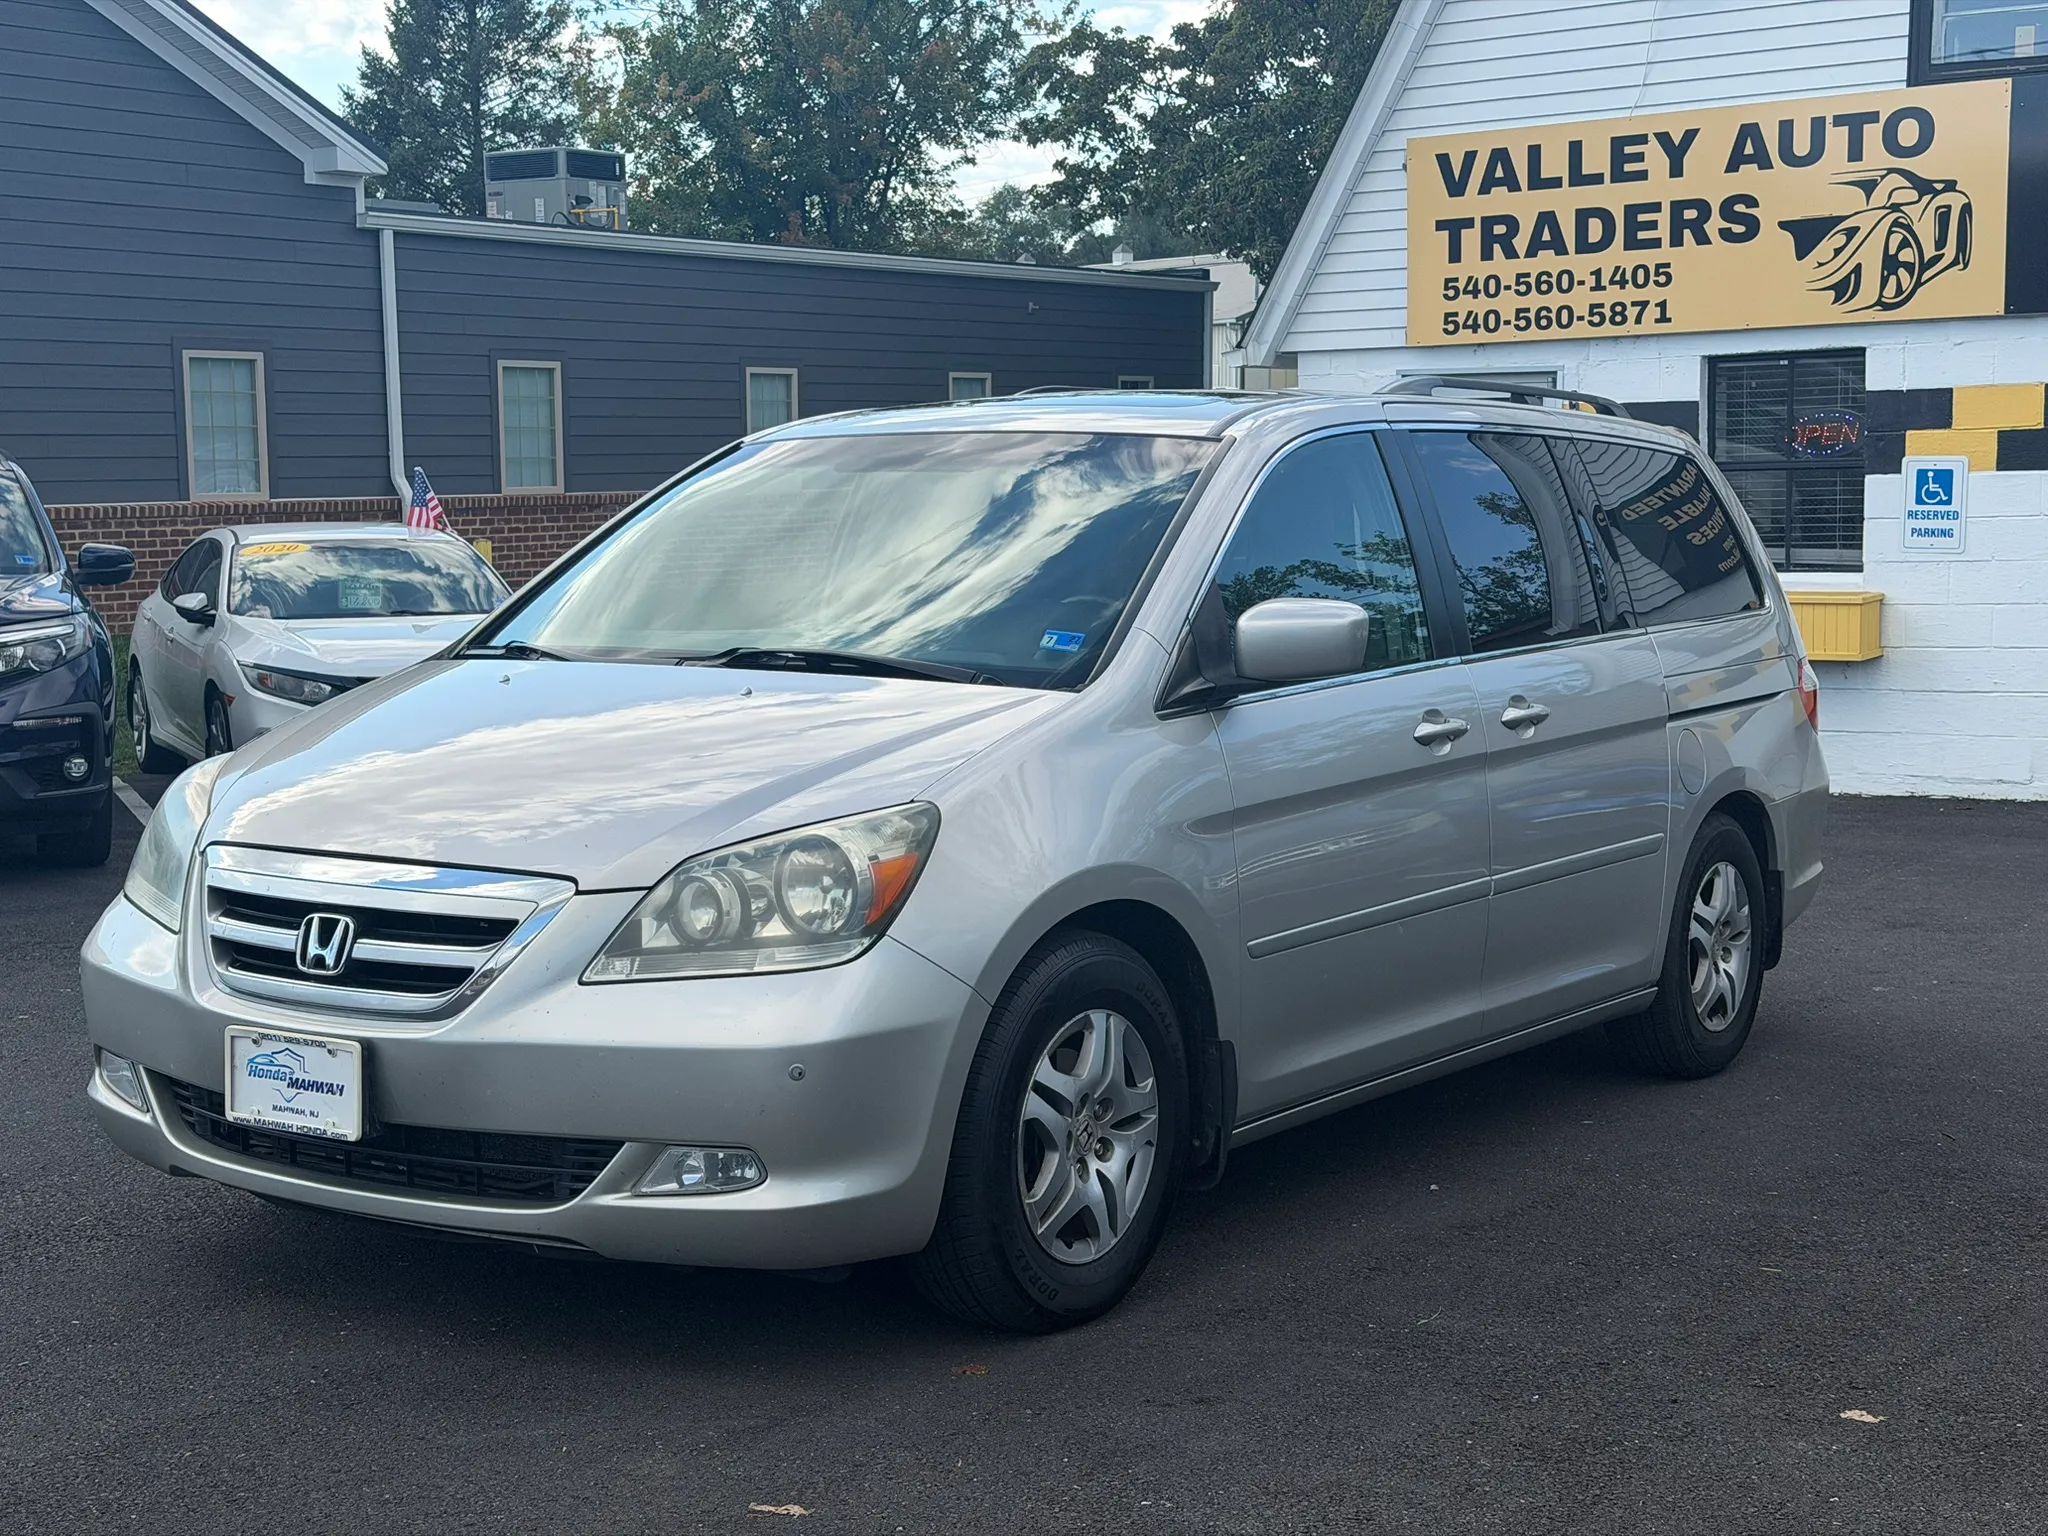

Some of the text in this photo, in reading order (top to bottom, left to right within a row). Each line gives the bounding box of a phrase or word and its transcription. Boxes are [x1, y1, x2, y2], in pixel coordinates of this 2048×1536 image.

[1434, 106, 1936, 199] VALLEY AUTO
[1434, 193, 1761, 265] TRADERS
[1442, 261, 1674, 302] 540-560-1405
[1441, 298, 1673, 336] 540-560-5871
[1784, 422, 1860, 446] OPEN
[1907, 509, 1960, 521] RESERVED
[1910, 527, 1955, 539] PARKING
[250, 543, 300, 556] 2020
[1046, 636, 1054, 644] 7
[283, 1034, 327, 1049] 529-5700
[248, 1064, 288, 1082] Honda
[287, 1076, 345, 1097] MAHWAH
[271, 1104, 320, 1119] MAHWAH, NJ
